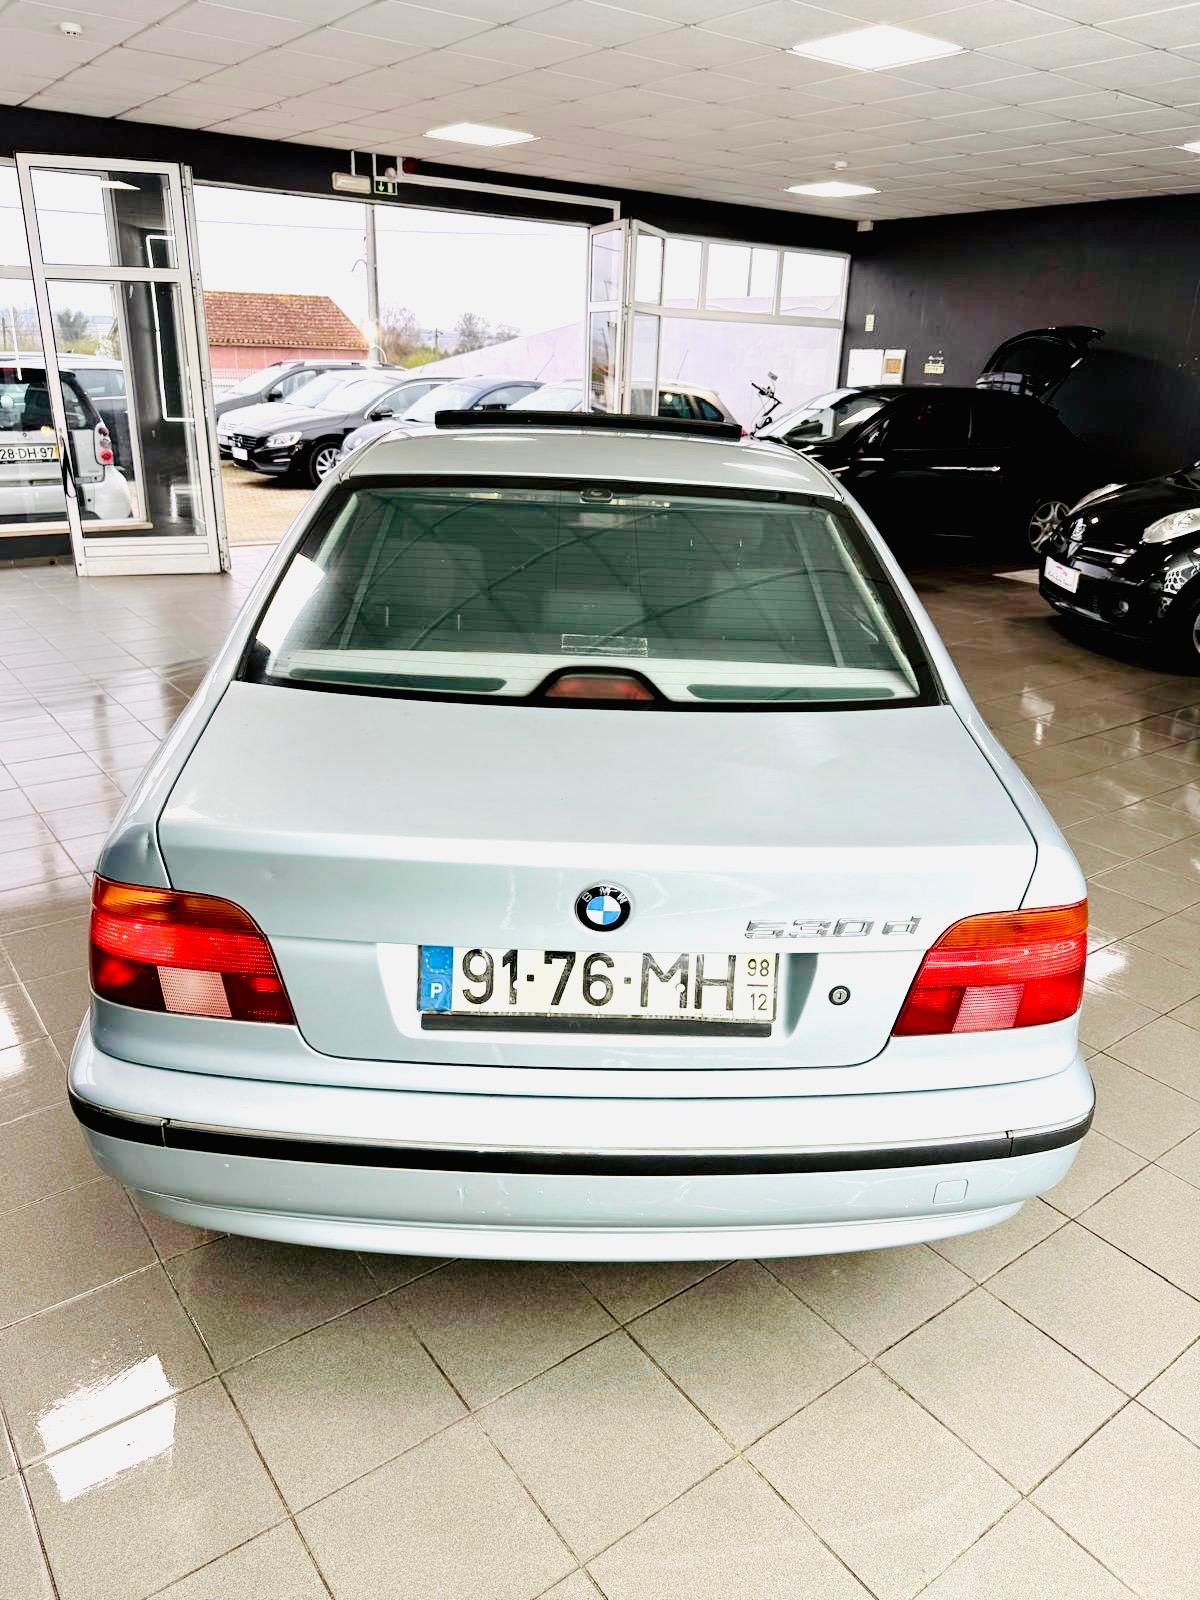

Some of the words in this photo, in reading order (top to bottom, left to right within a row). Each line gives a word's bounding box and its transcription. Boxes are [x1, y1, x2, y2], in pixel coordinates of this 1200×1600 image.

[582, 885, 629, 905] BMW
[747, 958, 770, 977] 98
[430, 982, 443, 999] P
[750, 993, 768, 1011] 12
